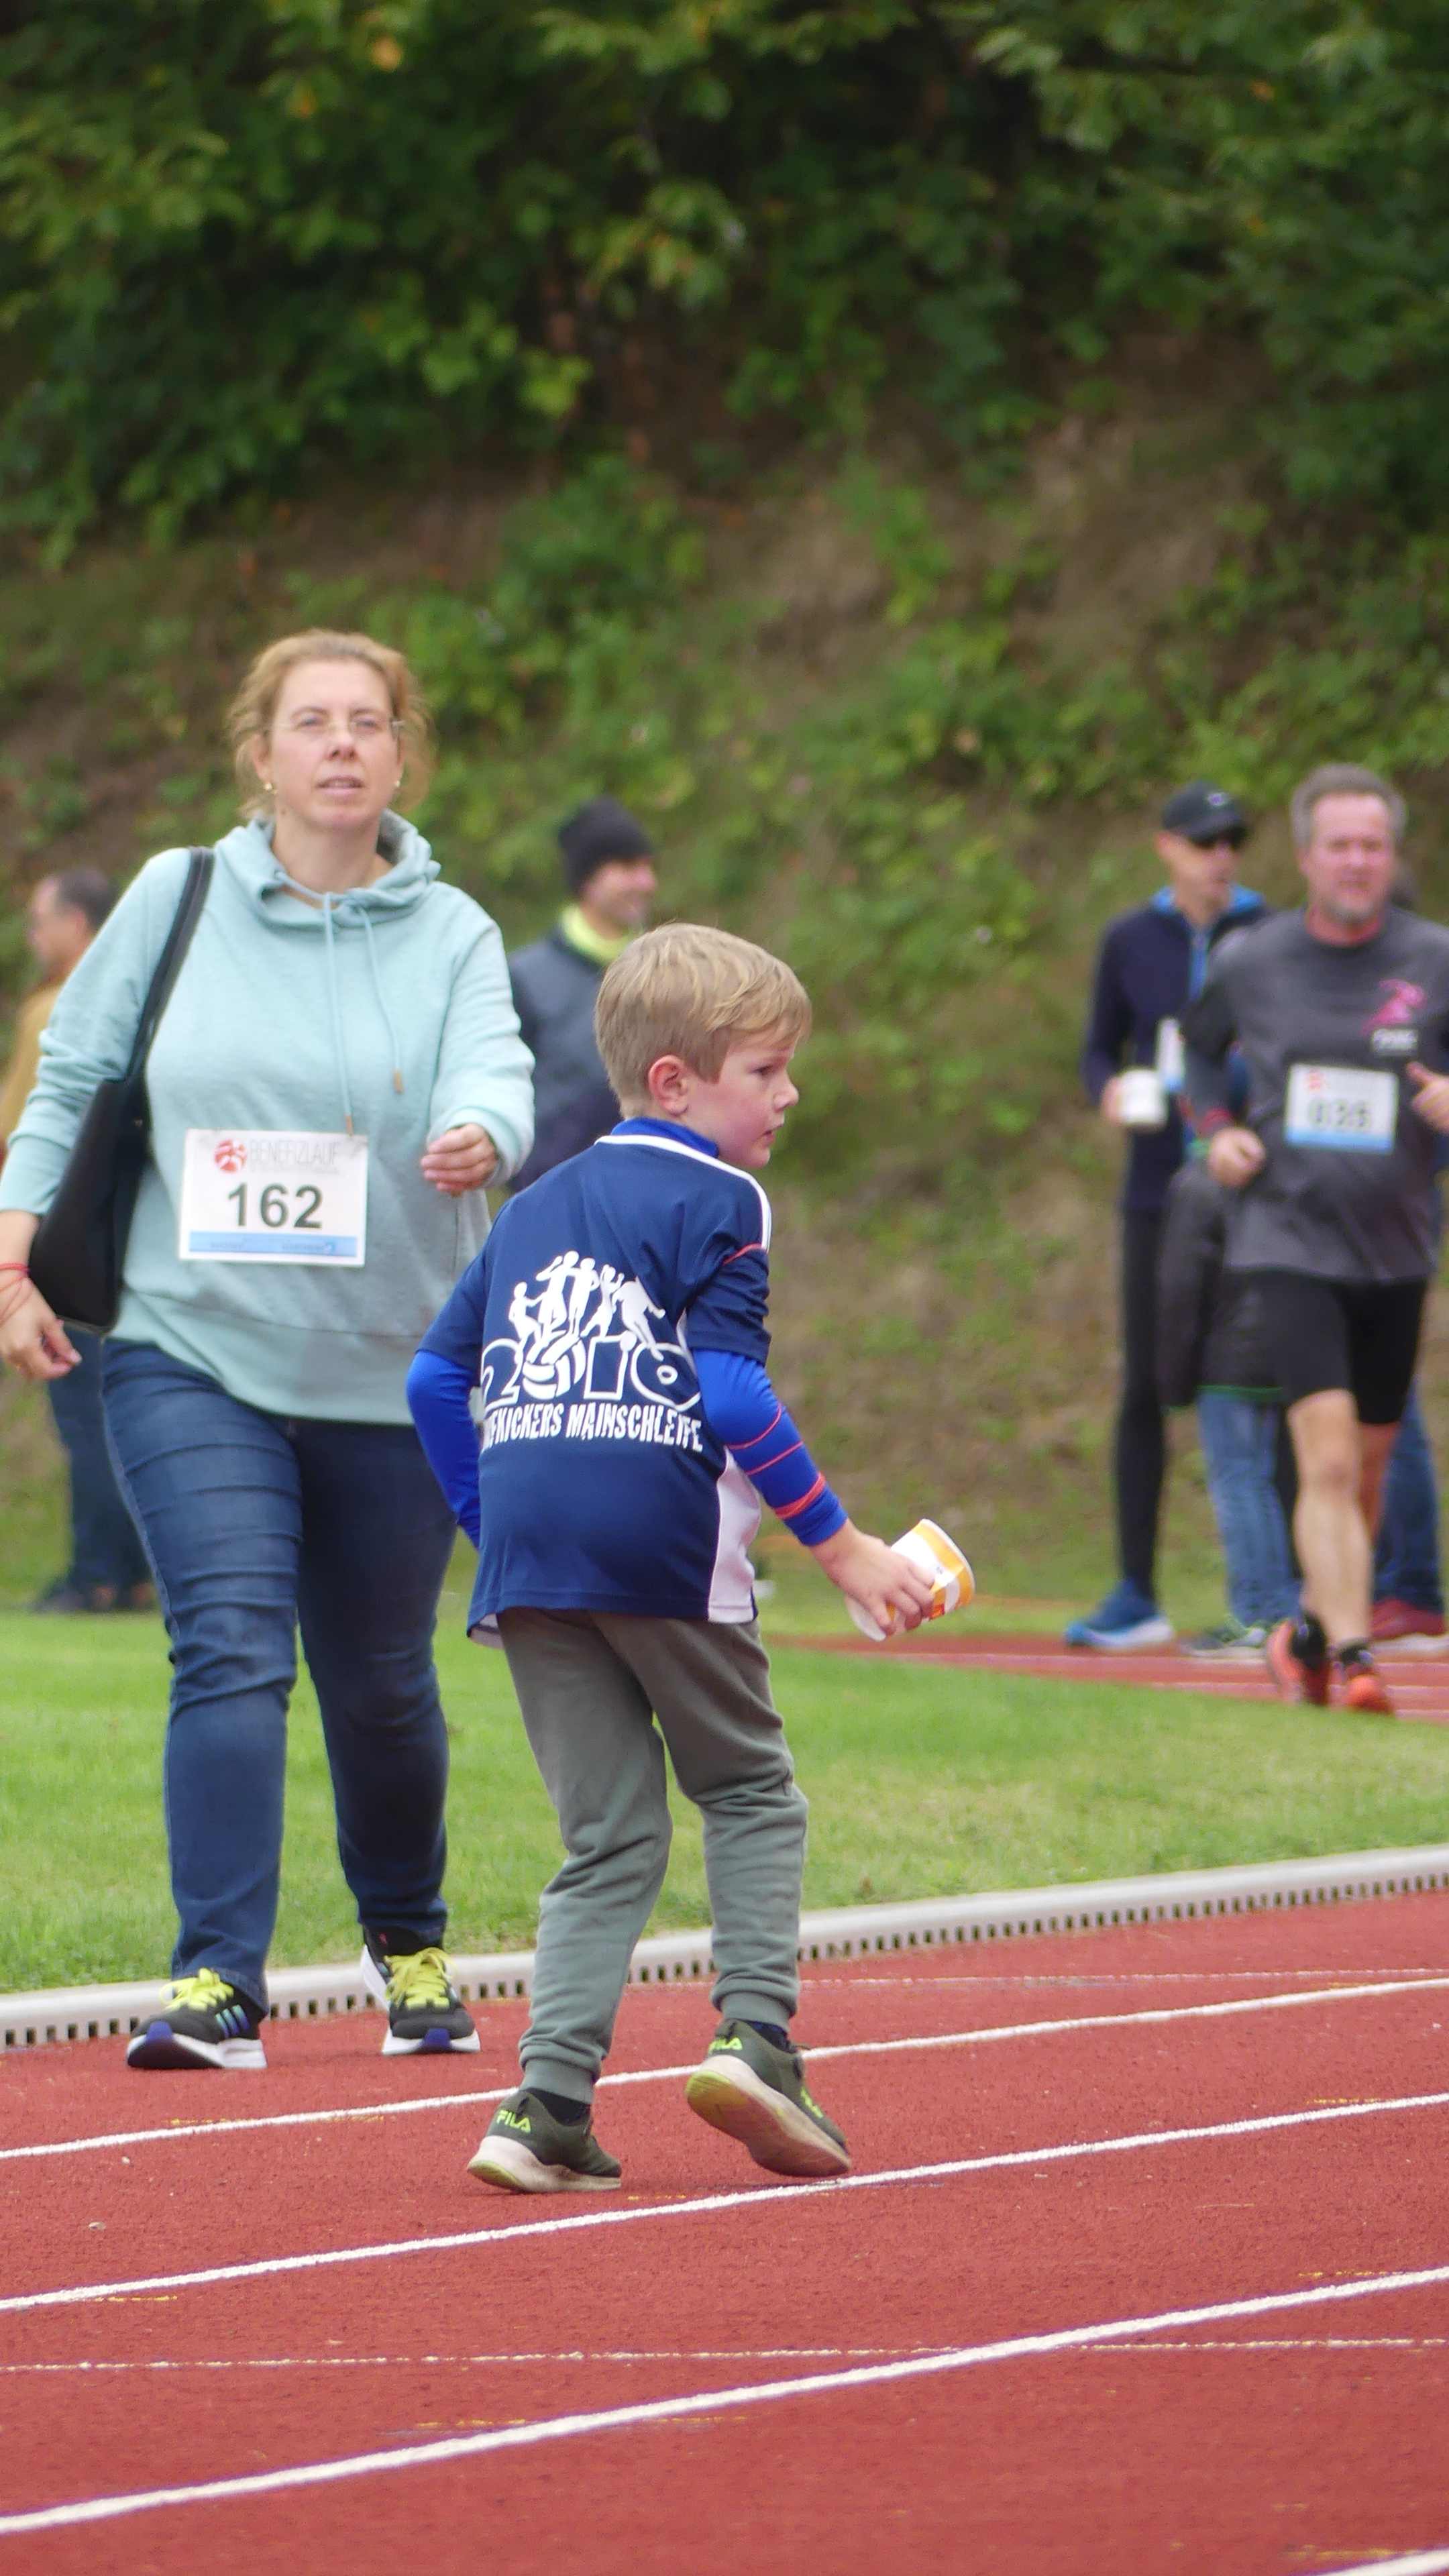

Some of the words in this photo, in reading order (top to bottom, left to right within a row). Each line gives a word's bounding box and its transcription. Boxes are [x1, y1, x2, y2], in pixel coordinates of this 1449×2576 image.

[227, 1182, 323, 1229] 162
[566, 1401, 704, 1453] MAINSCHLEIFE
[496, 2109, 531, 2134] FILA
